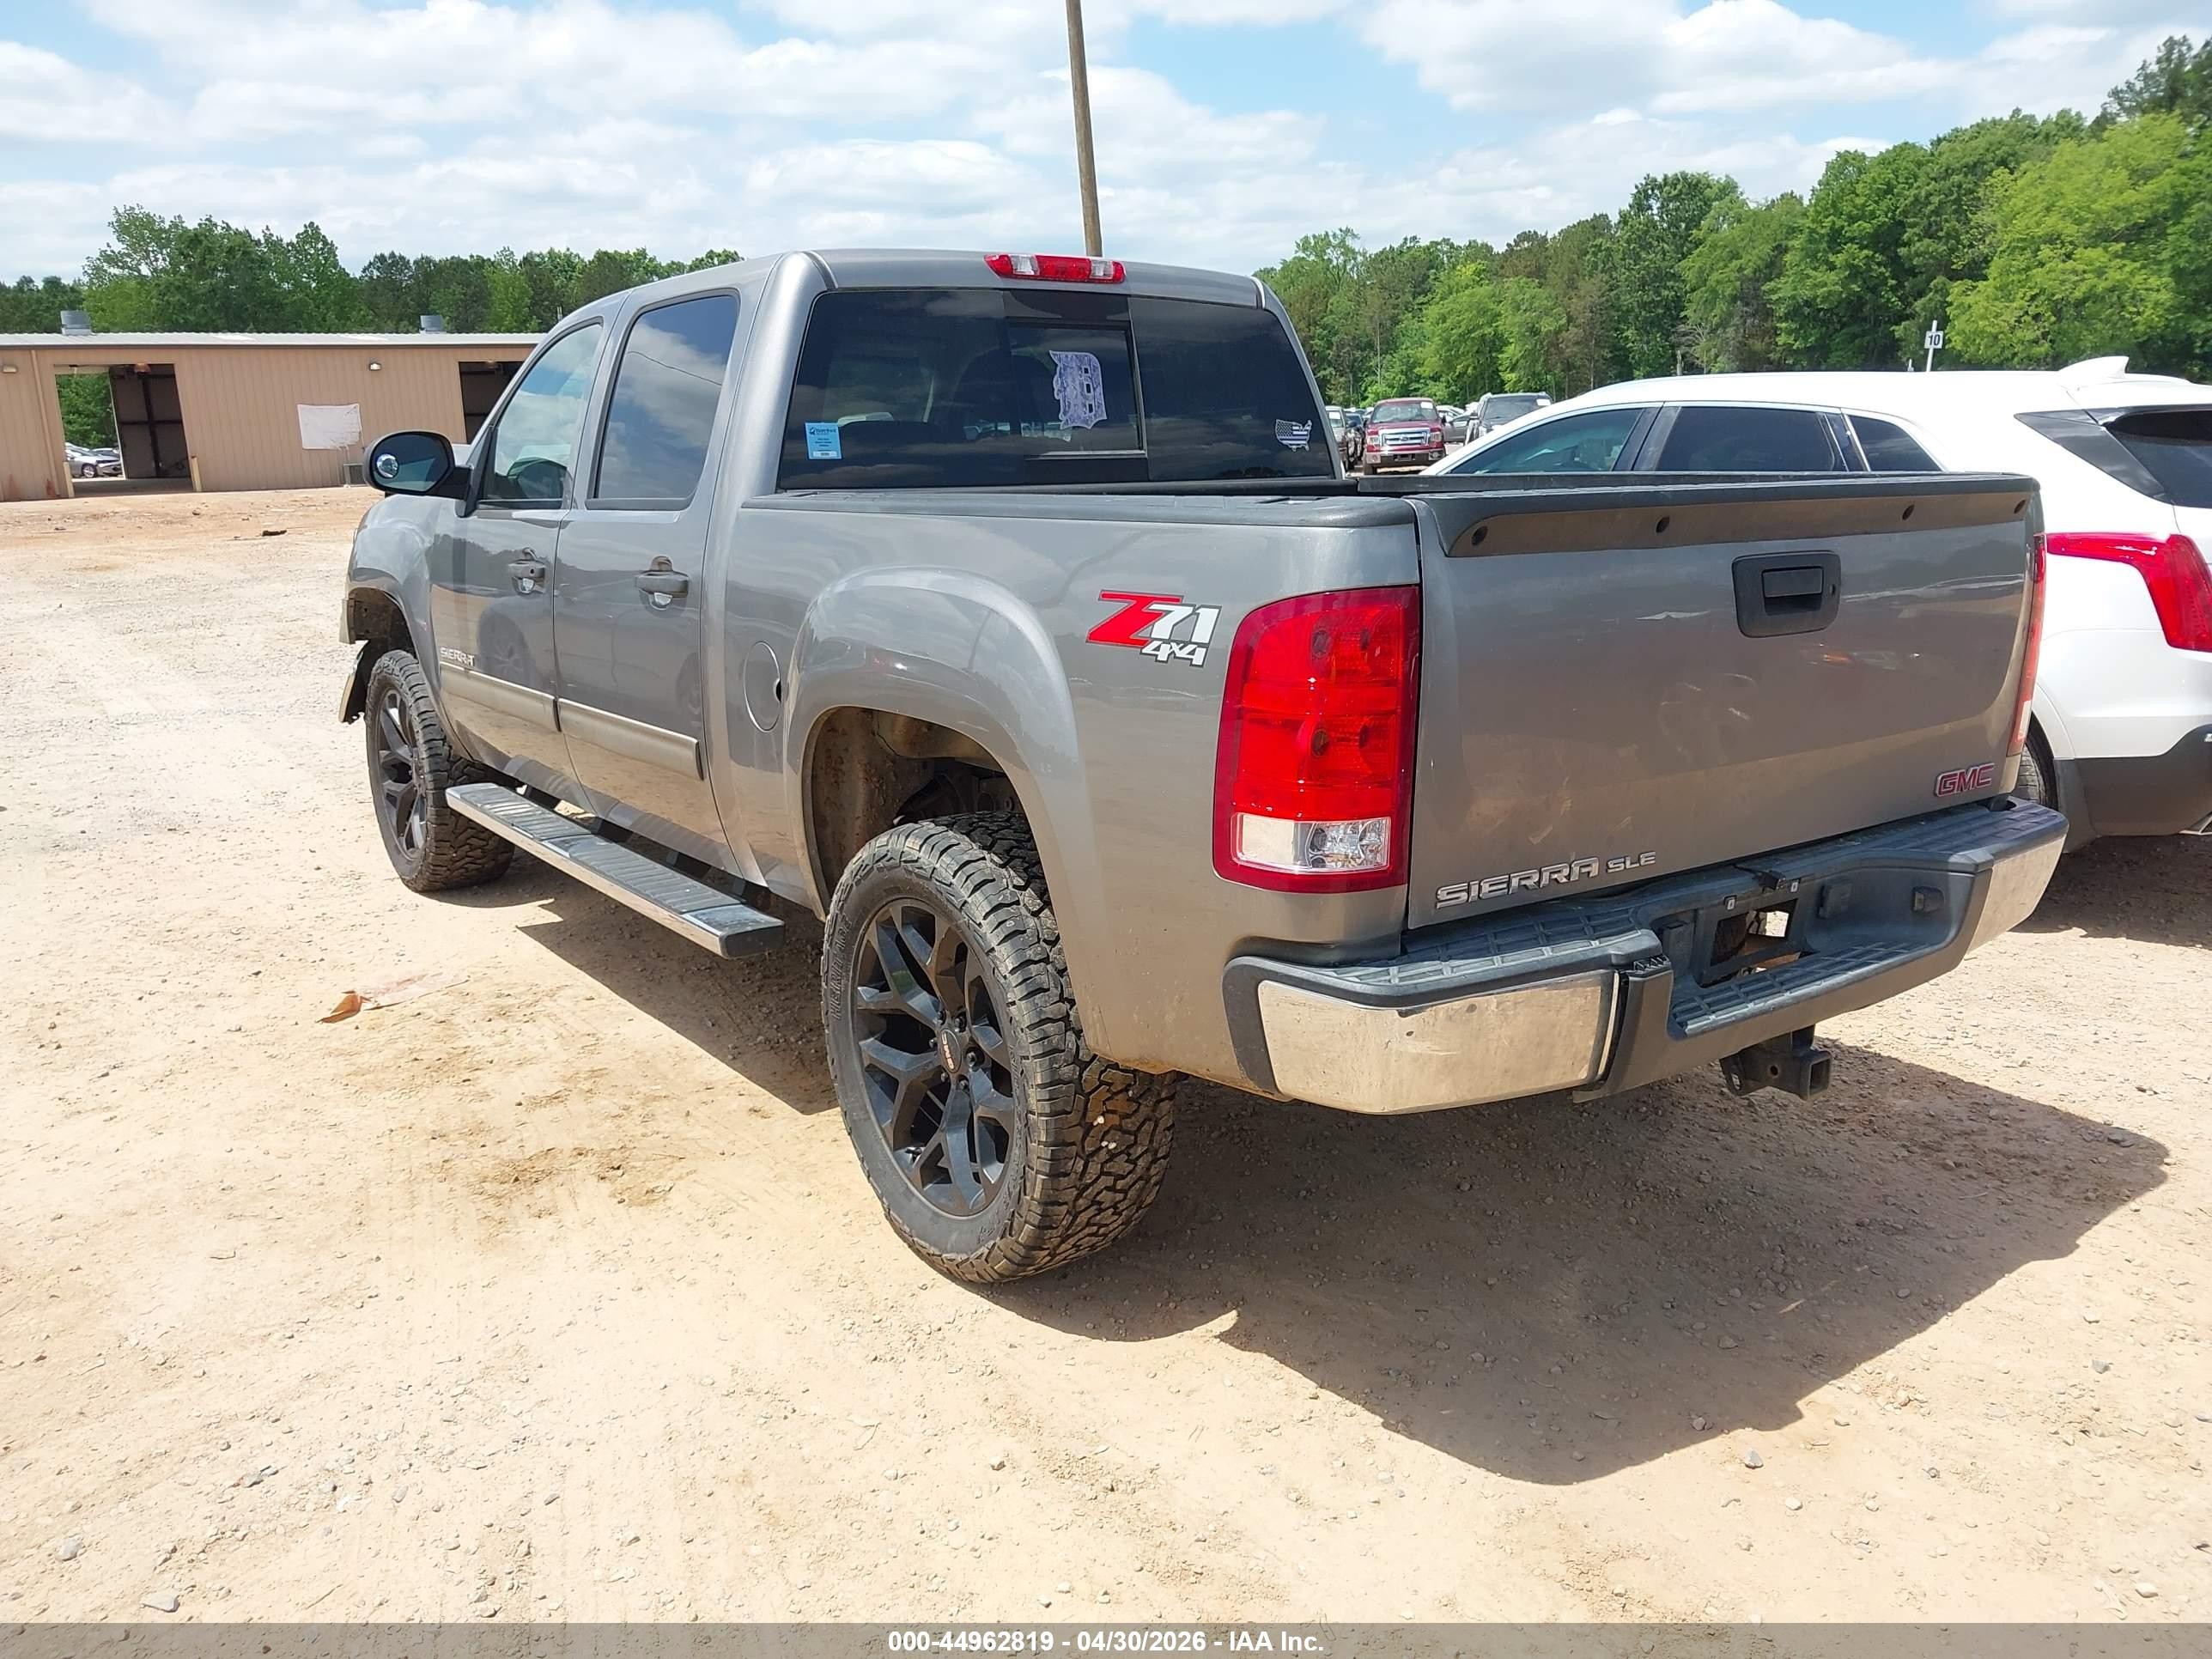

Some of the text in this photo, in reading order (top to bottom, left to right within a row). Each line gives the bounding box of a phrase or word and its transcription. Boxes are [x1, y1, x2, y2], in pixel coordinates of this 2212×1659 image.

[1928, 334, 1941, 346] 10
[1086, 590, 1222, 648] Z71
[1936, 763, 1995, 797] GMC
[1436, 851, 1656, 910] SIERRA SLE
